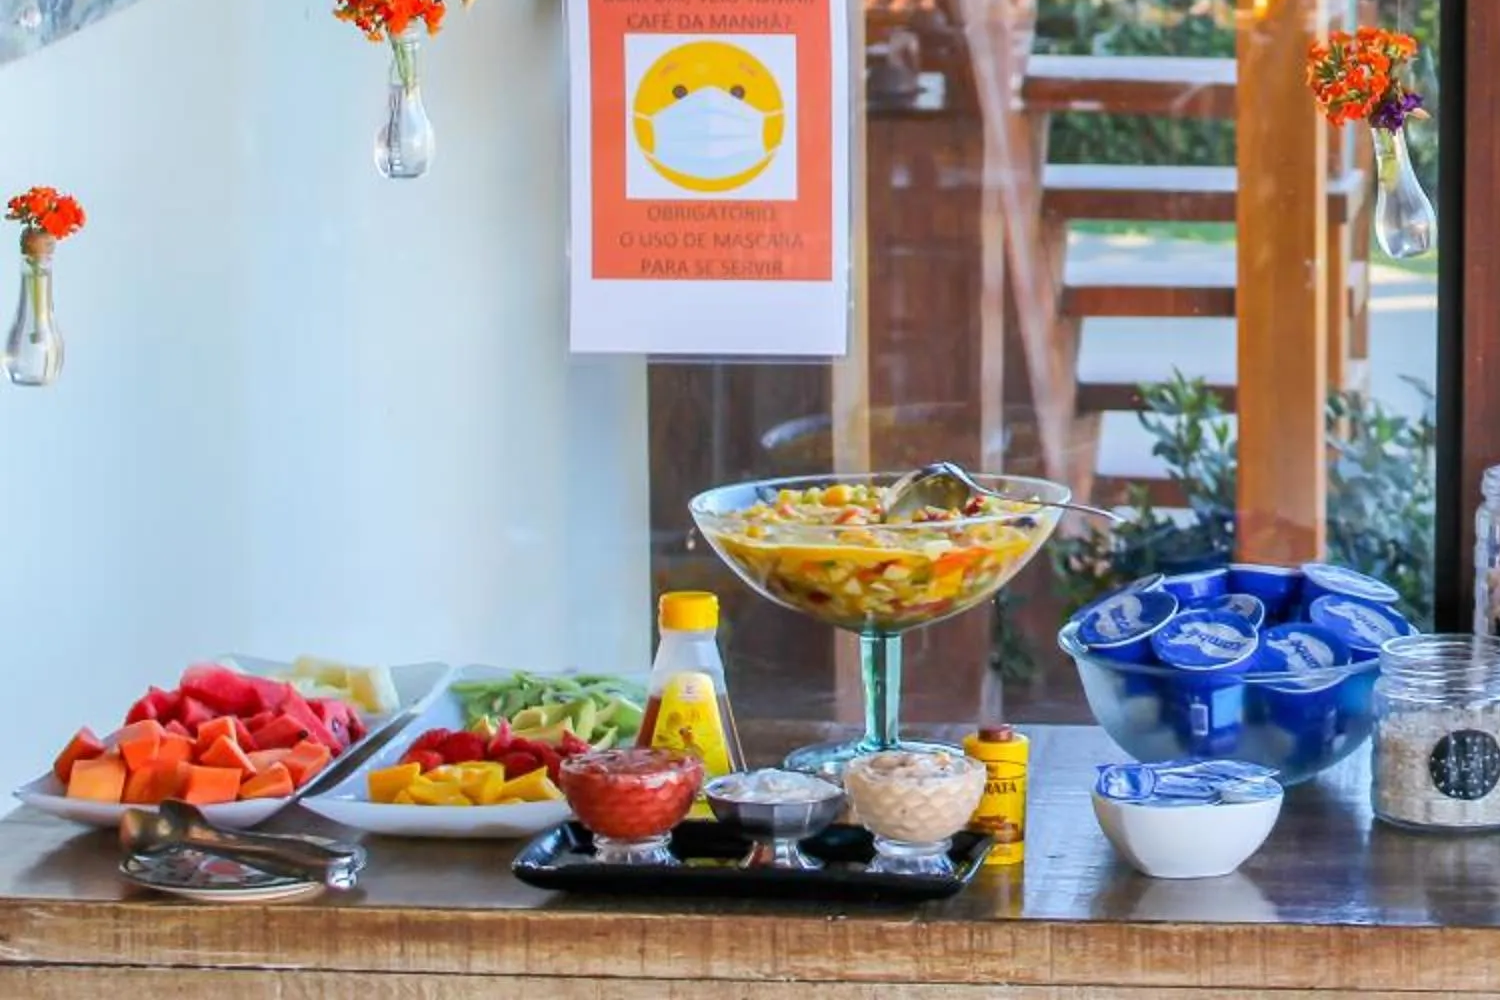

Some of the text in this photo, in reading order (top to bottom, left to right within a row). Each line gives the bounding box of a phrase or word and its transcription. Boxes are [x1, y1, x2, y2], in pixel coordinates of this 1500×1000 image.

[627, 10, 670, 29] CAFÉ
[677, 13, 704, 29] DA
[618, 231, 634, 248] O
[639, 231, 678, 248] USO
[682, 231, 705, 248] DE
[640, 258, 689, 275] PARA
[721, 258, 783, 275] SERVIR
